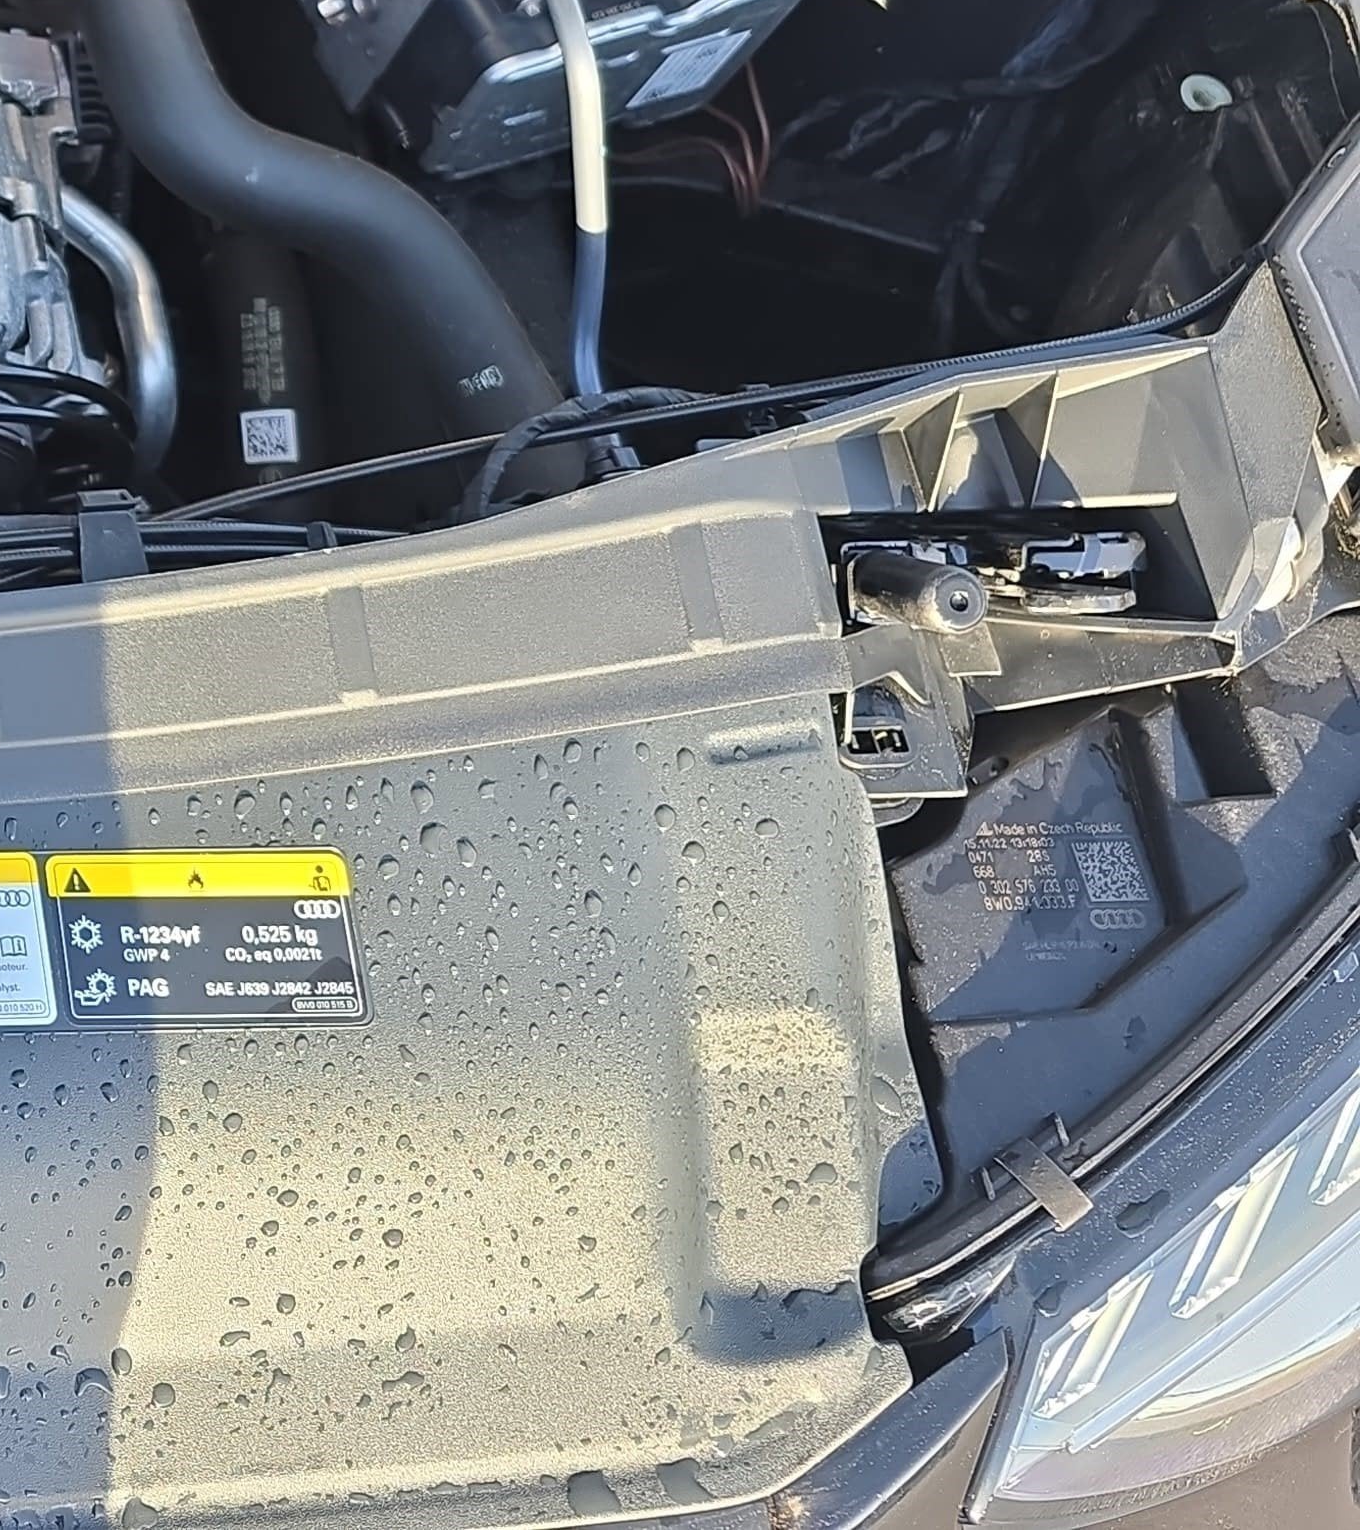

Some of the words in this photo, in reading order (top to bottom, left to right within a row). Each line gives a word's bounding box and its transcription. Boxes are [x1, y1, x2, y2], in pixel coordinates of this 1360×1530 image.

[993, 823, 1024, 835] Made
[1027, 822, 1037, 834] in
[1039, 821, 1075, 834] Czech
[1076, 822, 1123, 836] Republic
[964, 838, 1008, 849] 15.11.22
[1010, 837, 1055, 848] 13:18:03
[968, 851, 994, 863] 0471
[973, 865, 995, 878] 668
[990, 881, 1012, 894] 302
[1014, 879, 1036, 894] 576
[1040, 879, 1061, 893] 233
[1065, 878, 1079, 892] 00
[120, 926, 200, 945] R-1234yf
[242, 925, 292, 945] 0,525
[294, 925, 318, 946] kg
[123, 949, 158, 962] GWP
[160, 949, 170, 962] 4
[254, 950, 273, 963] eq
[128, 978, 169, 997] PAG
[205, 982, 235, 996] SAE
[237, 982, 270, 996] J639
[272, 982, 312, 996] J2842
[314, 982, 354, 995] J2845
